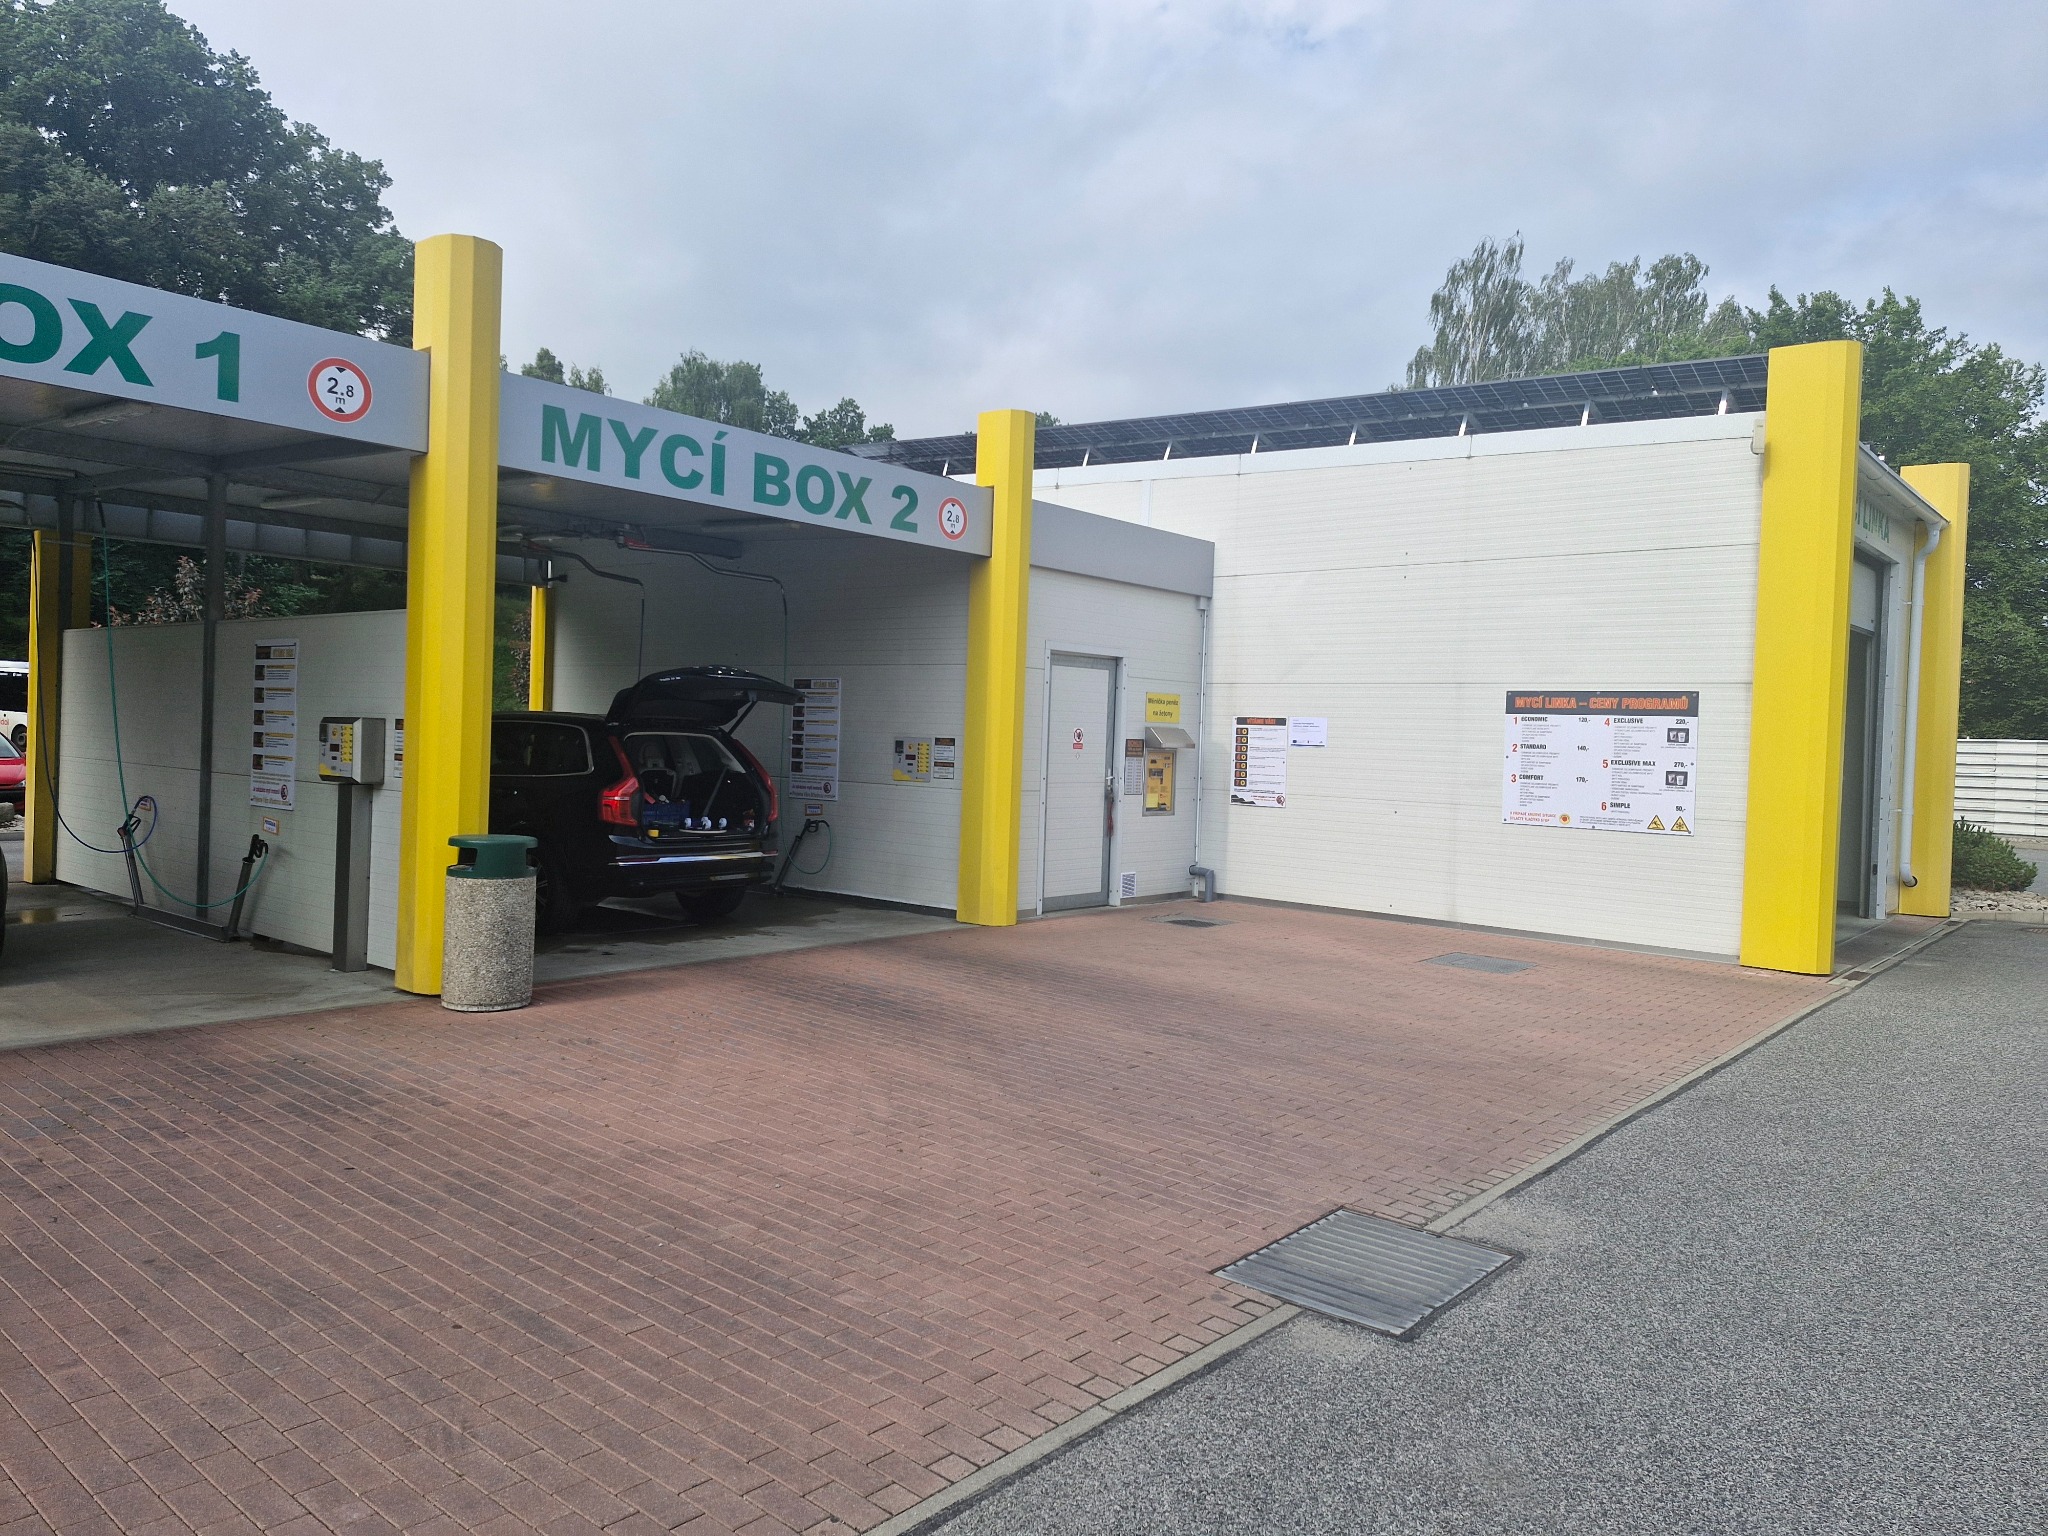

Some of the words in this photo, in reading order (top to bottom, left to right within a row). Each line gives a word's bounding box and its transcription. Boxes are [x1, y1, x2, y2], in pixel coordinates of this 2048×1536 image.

[195, 331, 240, 403] 1
[327, 377, 354, 398] 2.8
[335, 396, 346, 405] m
[541, 404, 729, 497] MYCÍ
[753, 452, 872, 525] BOX
[890, 484, 919, 533] 2
[947, 510, 960, 524] 2.8
[1515, 695, 1544, 708] MYCÍ
[1545, 697, 1577, 709] LINKA
[1589, 697, 1619, 709] CENY
[1621, 695, 1689, 710] PROGRAMŮ
[1159, 710, 1173, 718] žetony
[1513, 716, 1518, 725] 1
[1604, 718, 1610, 727] 4
[1512, 744, 1518, 752] 2
[1602, 759, 1608, 768] 5
[1511, 774, 1517, 783] 3
[1601, 802, 1607, 811] 6
